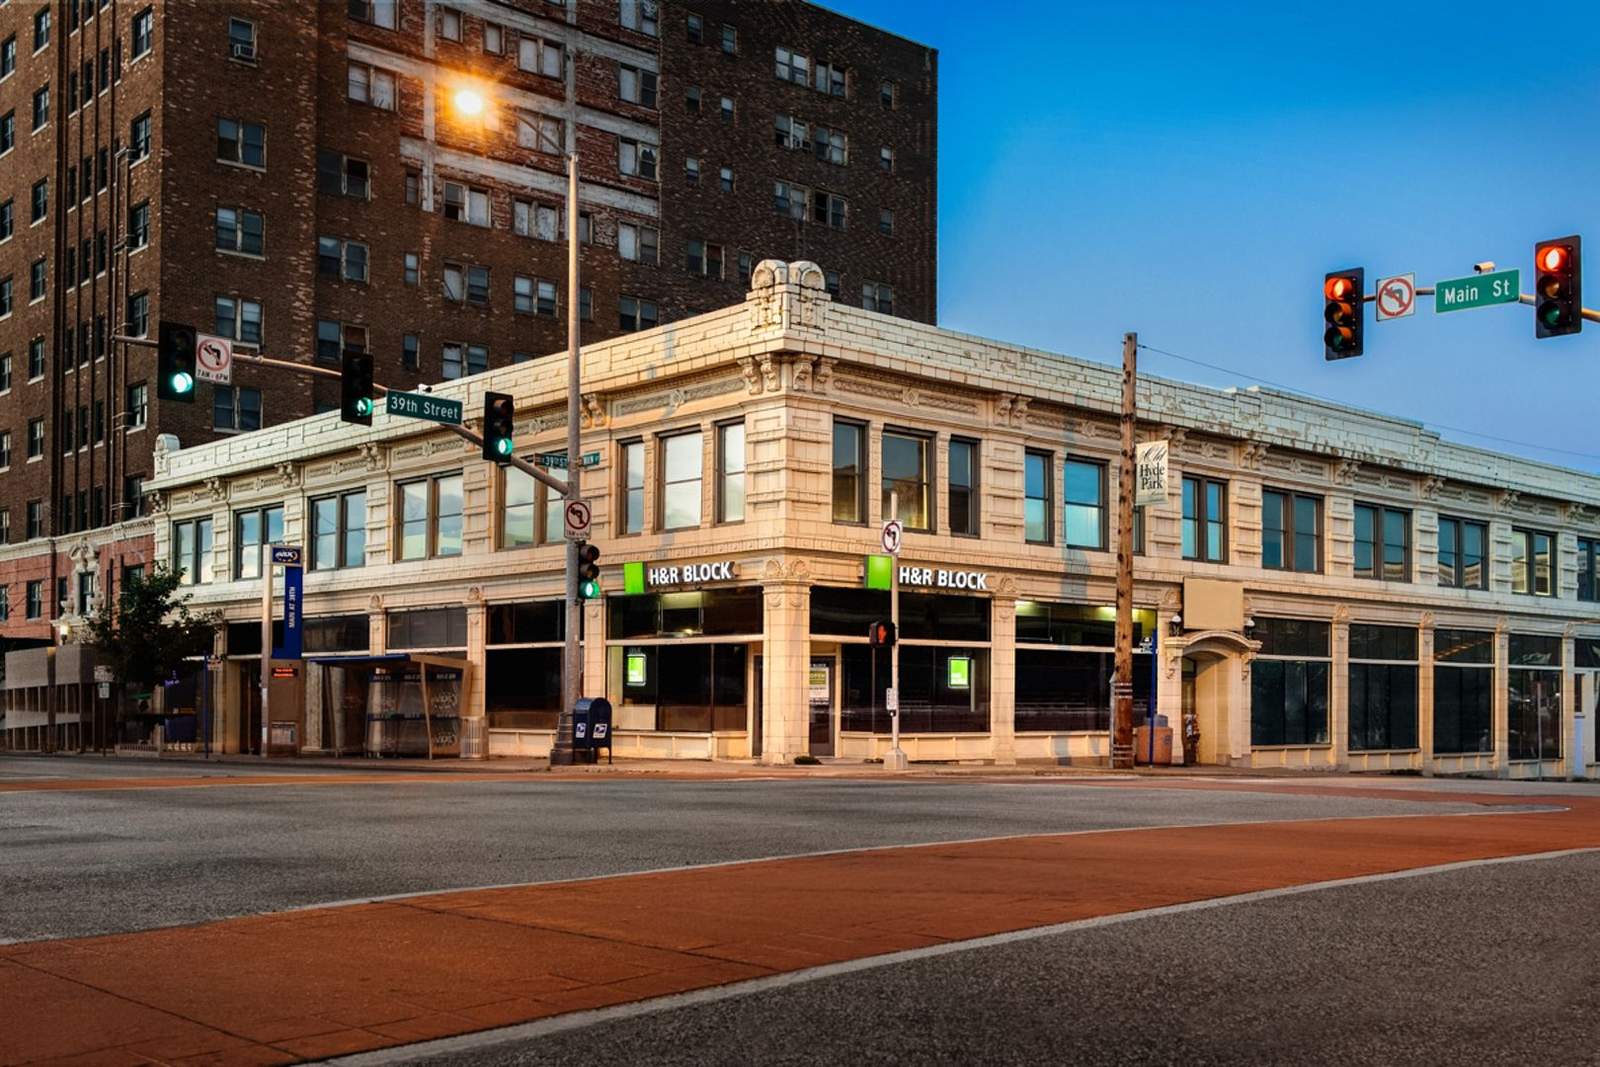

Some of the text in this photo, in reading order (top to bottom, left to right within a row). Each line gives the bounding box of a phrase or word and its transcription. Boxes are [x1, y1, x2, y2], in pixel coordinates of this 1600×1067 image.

[1444, 279, 1510, 304] Main St
[391, 396, 458, 419] 39th Street
[1140, 462, 1165, 480] Hyde
[1141, 477, 1163, 490] Park
[649, 561, 732, 586] H&R BLOCK
[899, 566, 987, 590] H&R BLOCK
